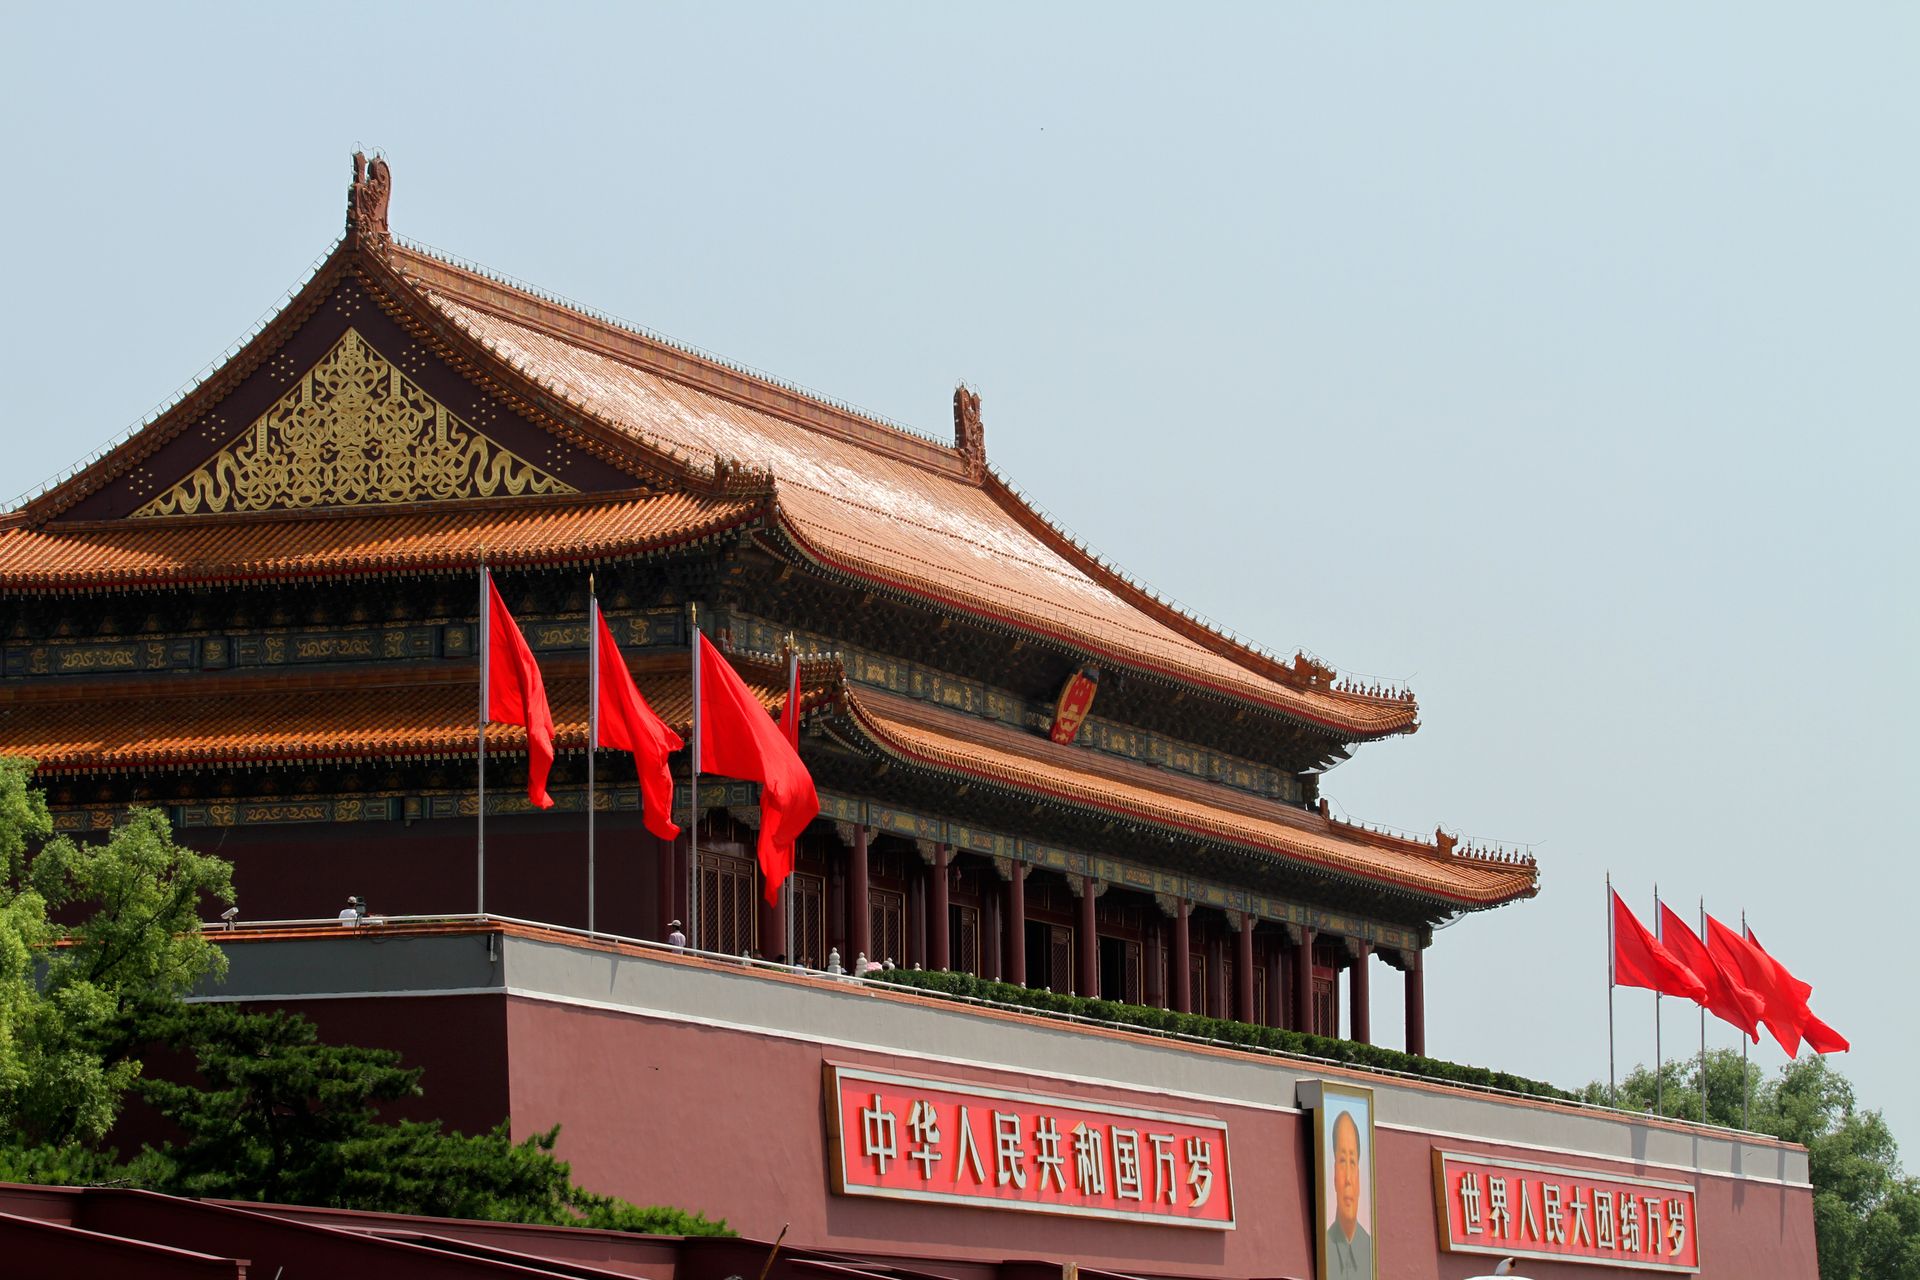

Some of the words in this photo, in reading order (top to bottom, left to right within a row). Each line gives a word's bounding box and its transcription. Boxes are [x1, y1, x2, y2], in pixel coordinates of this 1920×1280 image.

[861, 1093, 1213, 1208] 中华人民共和国万岁
[1460, 1171, 1686, 1257] 世界人民大团结万岁
